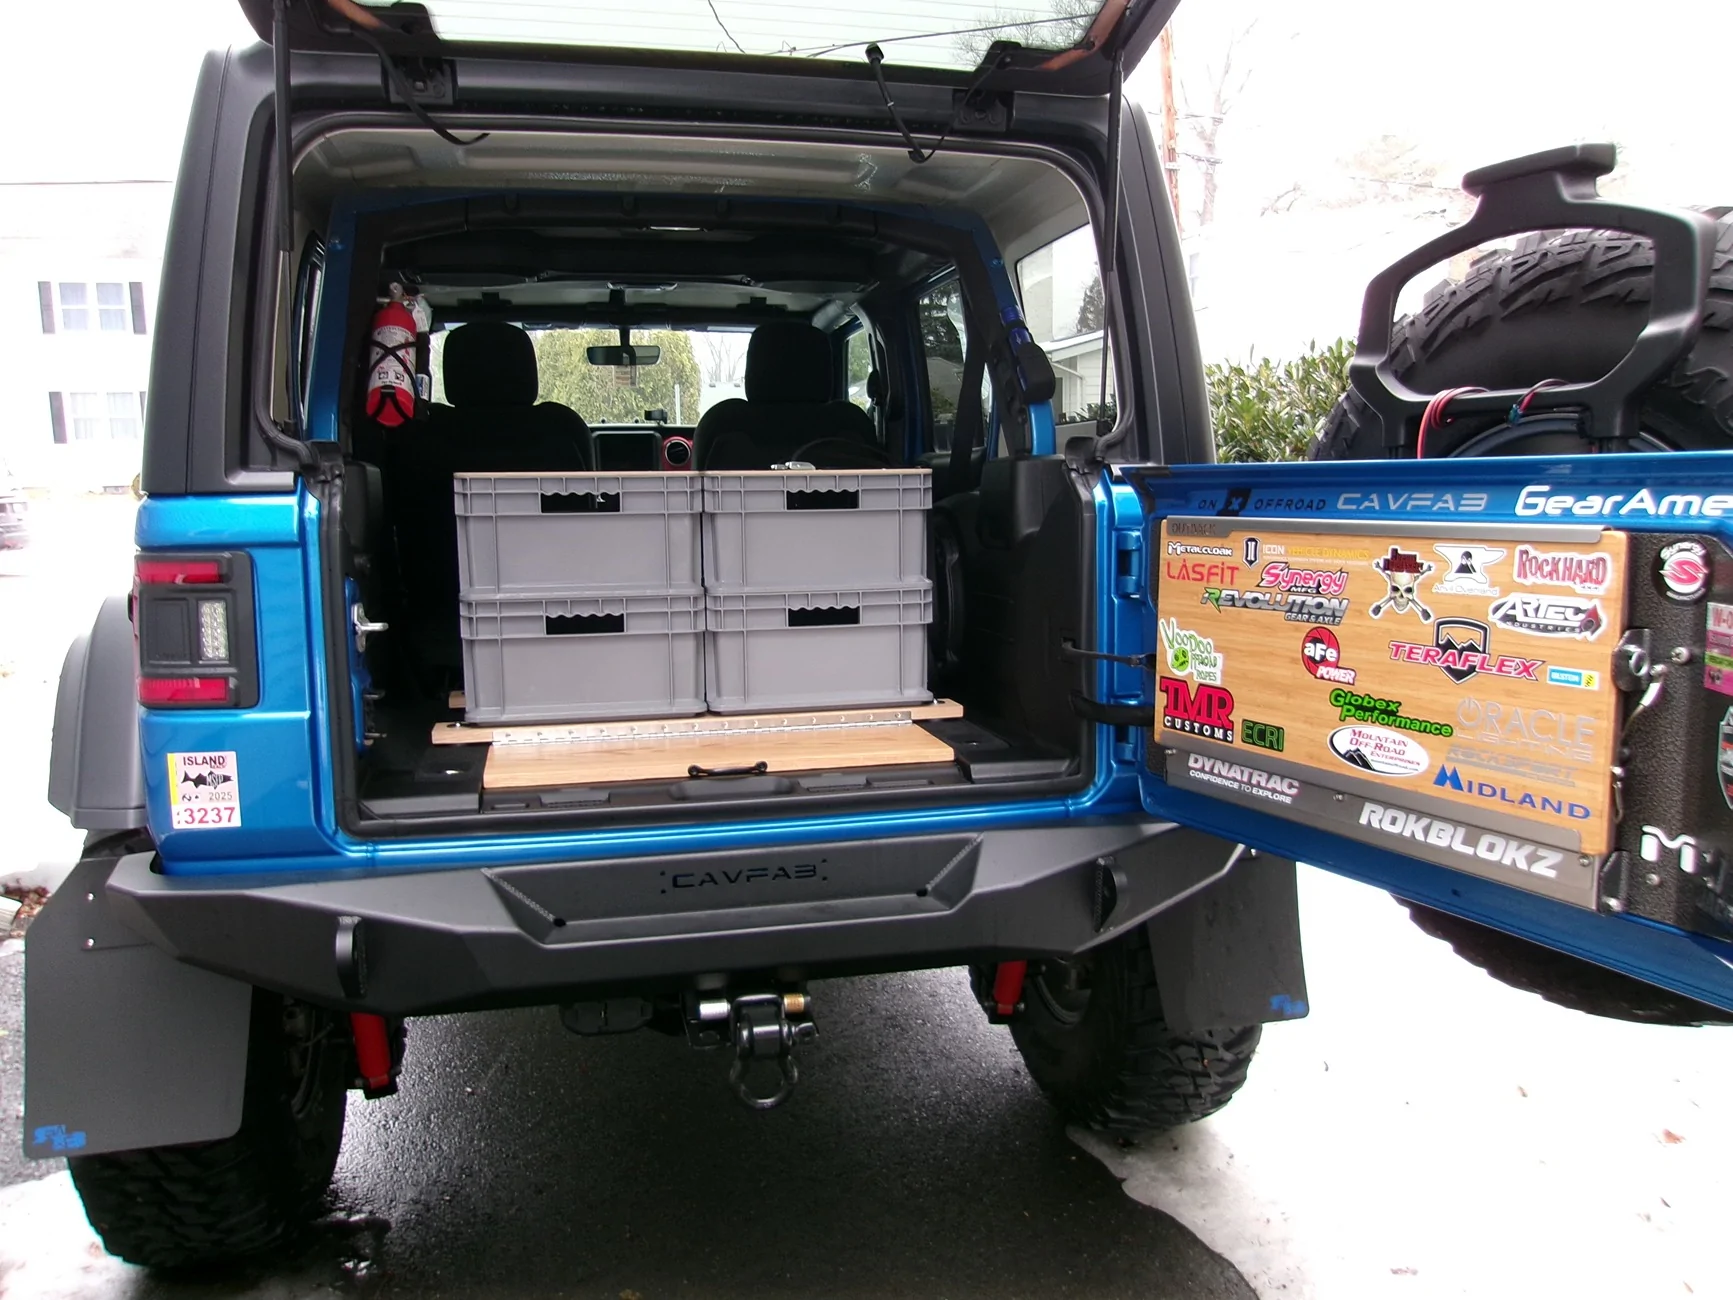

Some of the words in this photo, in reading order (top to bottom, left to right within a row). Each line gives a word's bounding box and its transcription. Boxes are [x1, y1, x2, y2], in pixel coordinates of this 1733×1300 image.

[1254, 499, 1327, 511] OFFROAD
[1262, 544, 1285, 555] ICON
[1660, 541, 1706, 561] Synergy
[1259, 562, 1348, 596] Synergy
[1200, 587, 1349, 617] REVOLUTION
[1489, 598, 1588, 622] ARTEC
[1285, 612, 1307, 622] GEAR
[1308, 615, 1317, 623] &
[1318, 615, 1342, 625] AXLE
[1303, 642, 1338, 662] aFe
[1389, 641, 1546, 681] TERAFLEX
[1316, 666, 1356, 684] POWER
[1160, 676, 1235, 730] TMR
[1330, 689, 1401, 713] Globex
[1164, 716, 1233, 742] CUSTOMS
[1340, 706, 1453, 737] Performance
[1457, 697, 1595, 750] ORACLE
[1242, 720, 1284, 751] ECRI
[183, 755, 226, 768] ISLAND
[1187, 753, 1300, 795] DYNATRAC
[208, 791, 233, 801] 2025
[1189, 769, 1239, 790] CONFIDENCE
[1240, 783, 1252, 793] TO
[1252, 787, 1293, 804] EXPLORE
[1433, 763, 1591, 820] MIDLAND
[183, 807, 236, 825] 3237
[1358, 802, 1564, 878] ROKBLOKZ
